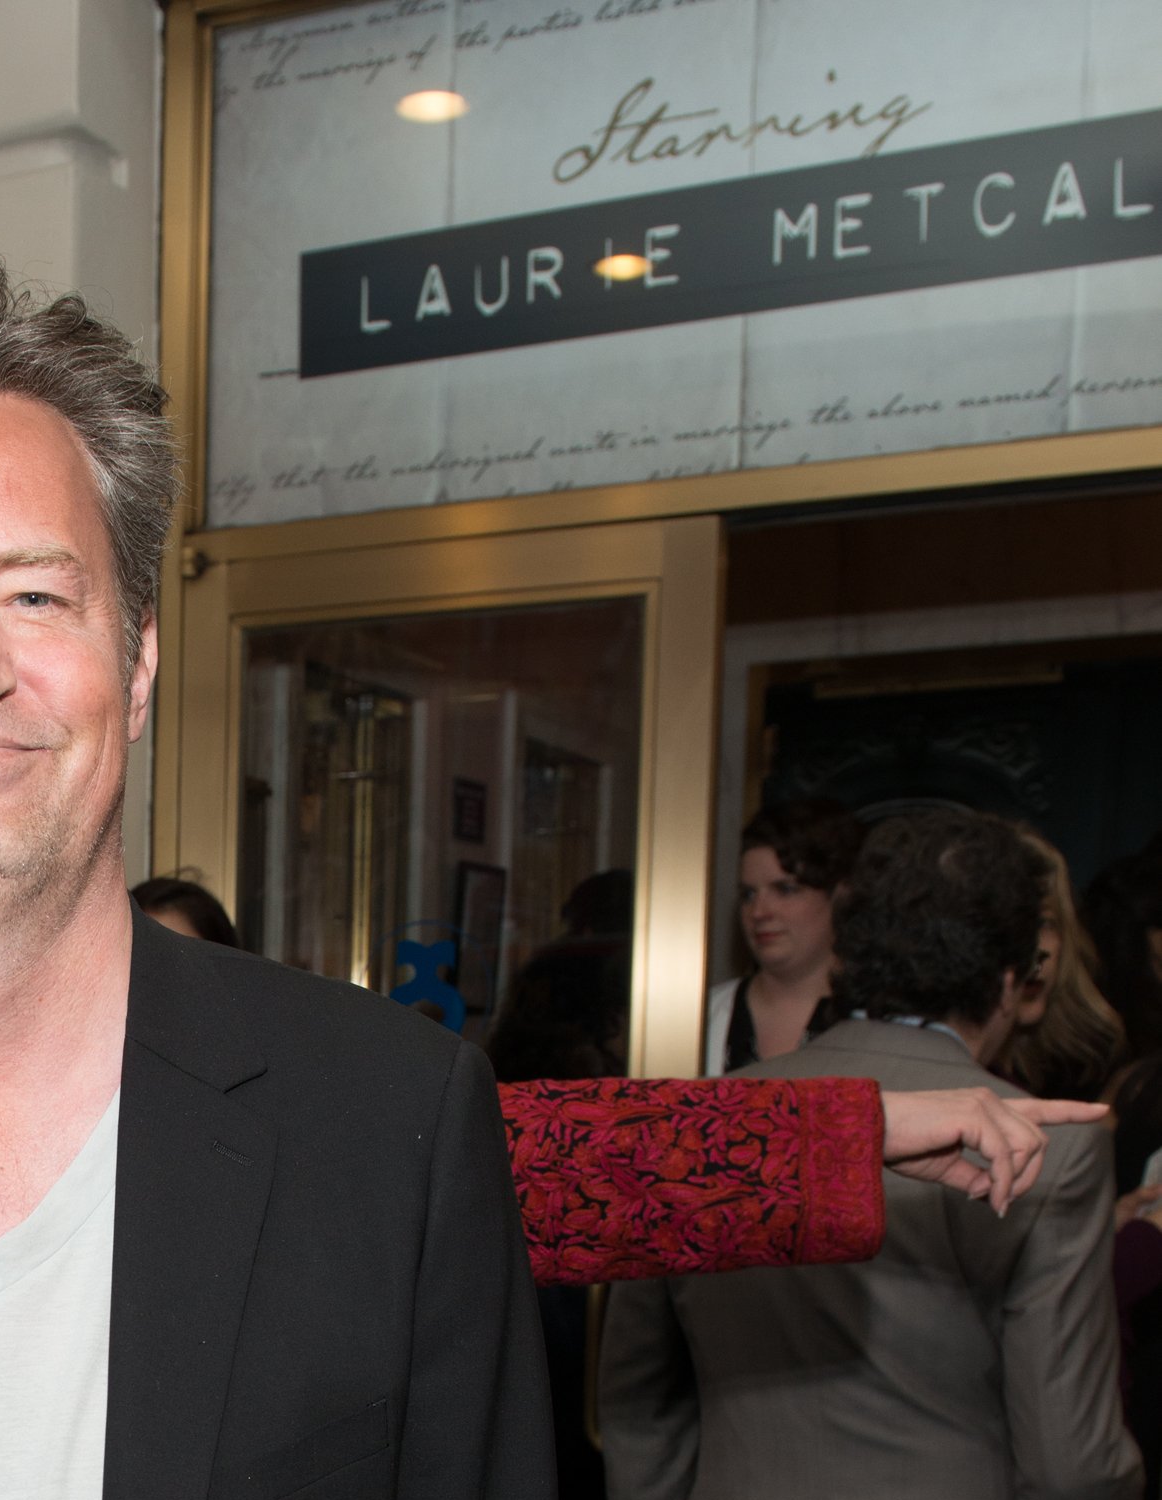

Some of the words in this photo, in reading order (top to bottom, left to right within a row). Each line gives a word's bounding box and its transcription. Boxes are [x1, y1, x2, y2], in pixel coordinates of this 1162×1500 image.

[552, 68, 935, 185] Starring
[360, 222, 681, 335] LAURIE
[771, 157, 1155, 268] METCAL
